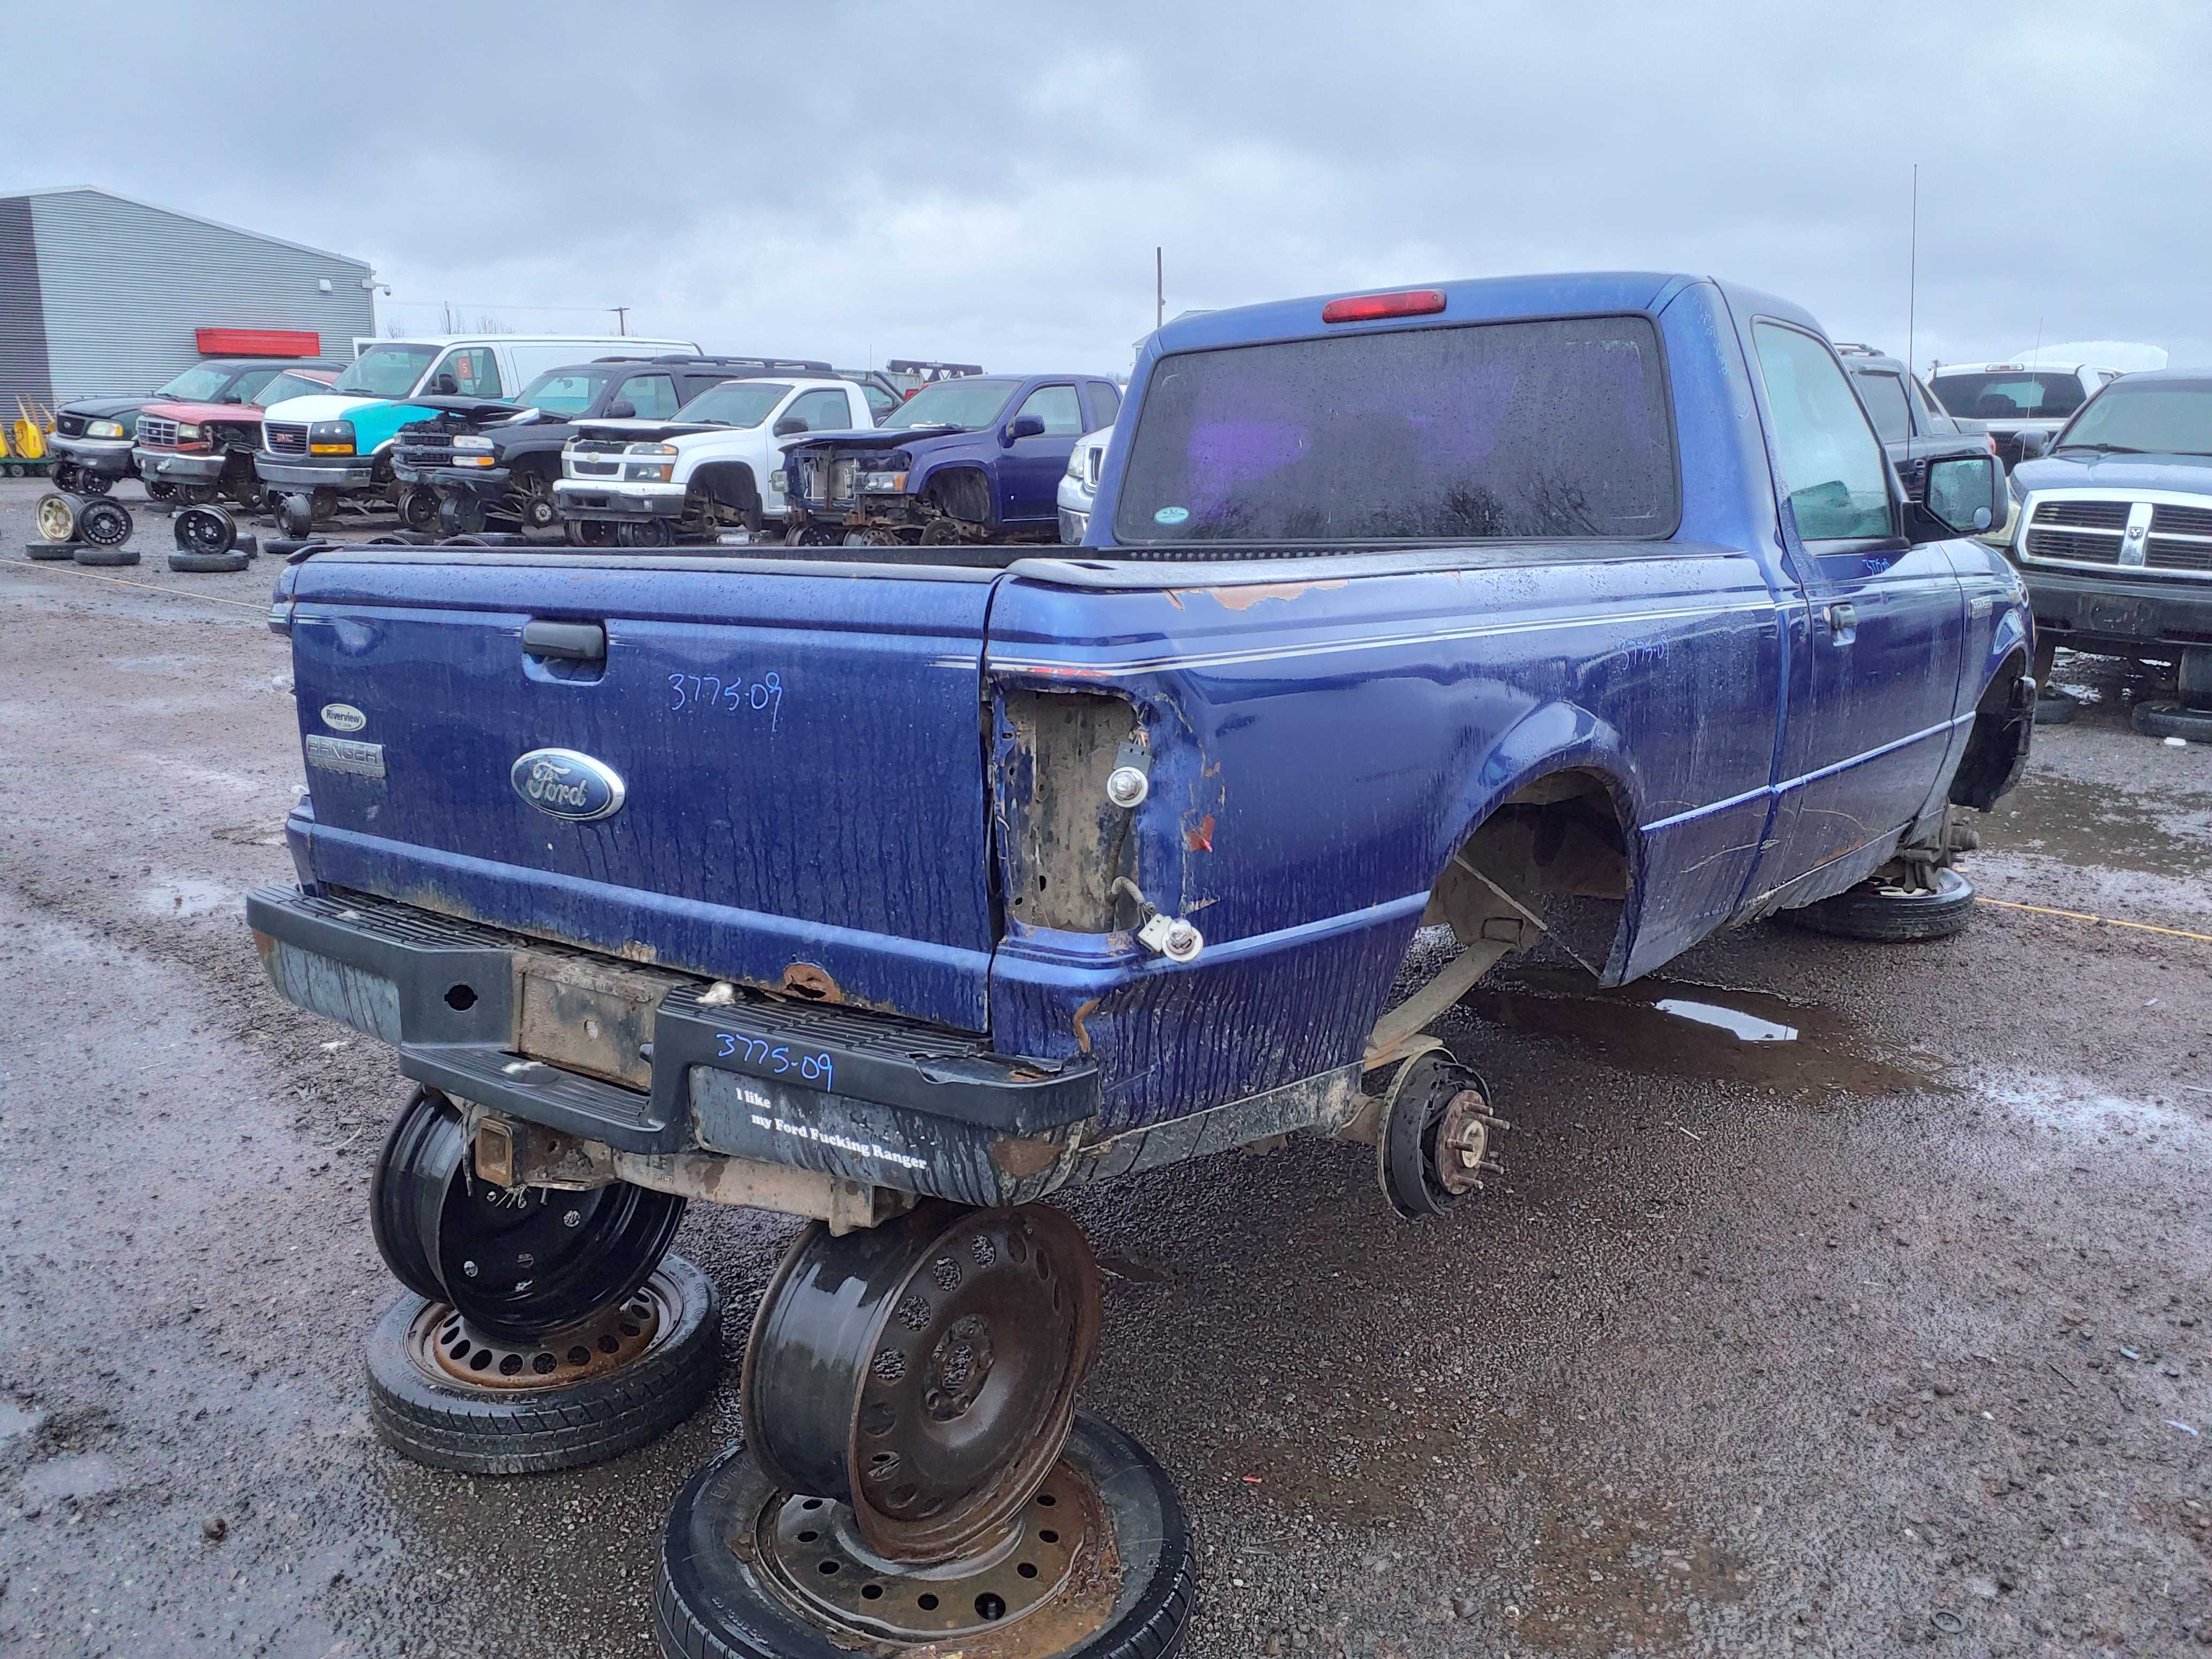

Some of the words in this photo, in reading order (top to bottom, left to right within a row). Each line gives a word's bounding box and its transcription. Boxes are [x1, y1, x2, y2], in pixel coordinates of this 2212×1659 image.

[462, 363, 468, 373] 5
[326, 709, 360, 723] Riverview
[308, 739, 378, 764] RANGER
[527, 761, 588, 807] Ford
[716, 1033, 833, 1093] 3775-09
[744, 1090, 771, 1109] like
[751, 1114, 772, 1130] my
[774, 1118, 808, 1138] Ford
[809, 1127, 871, 1157] Fucking
[871, 1144, 927, 1170] Ranger
